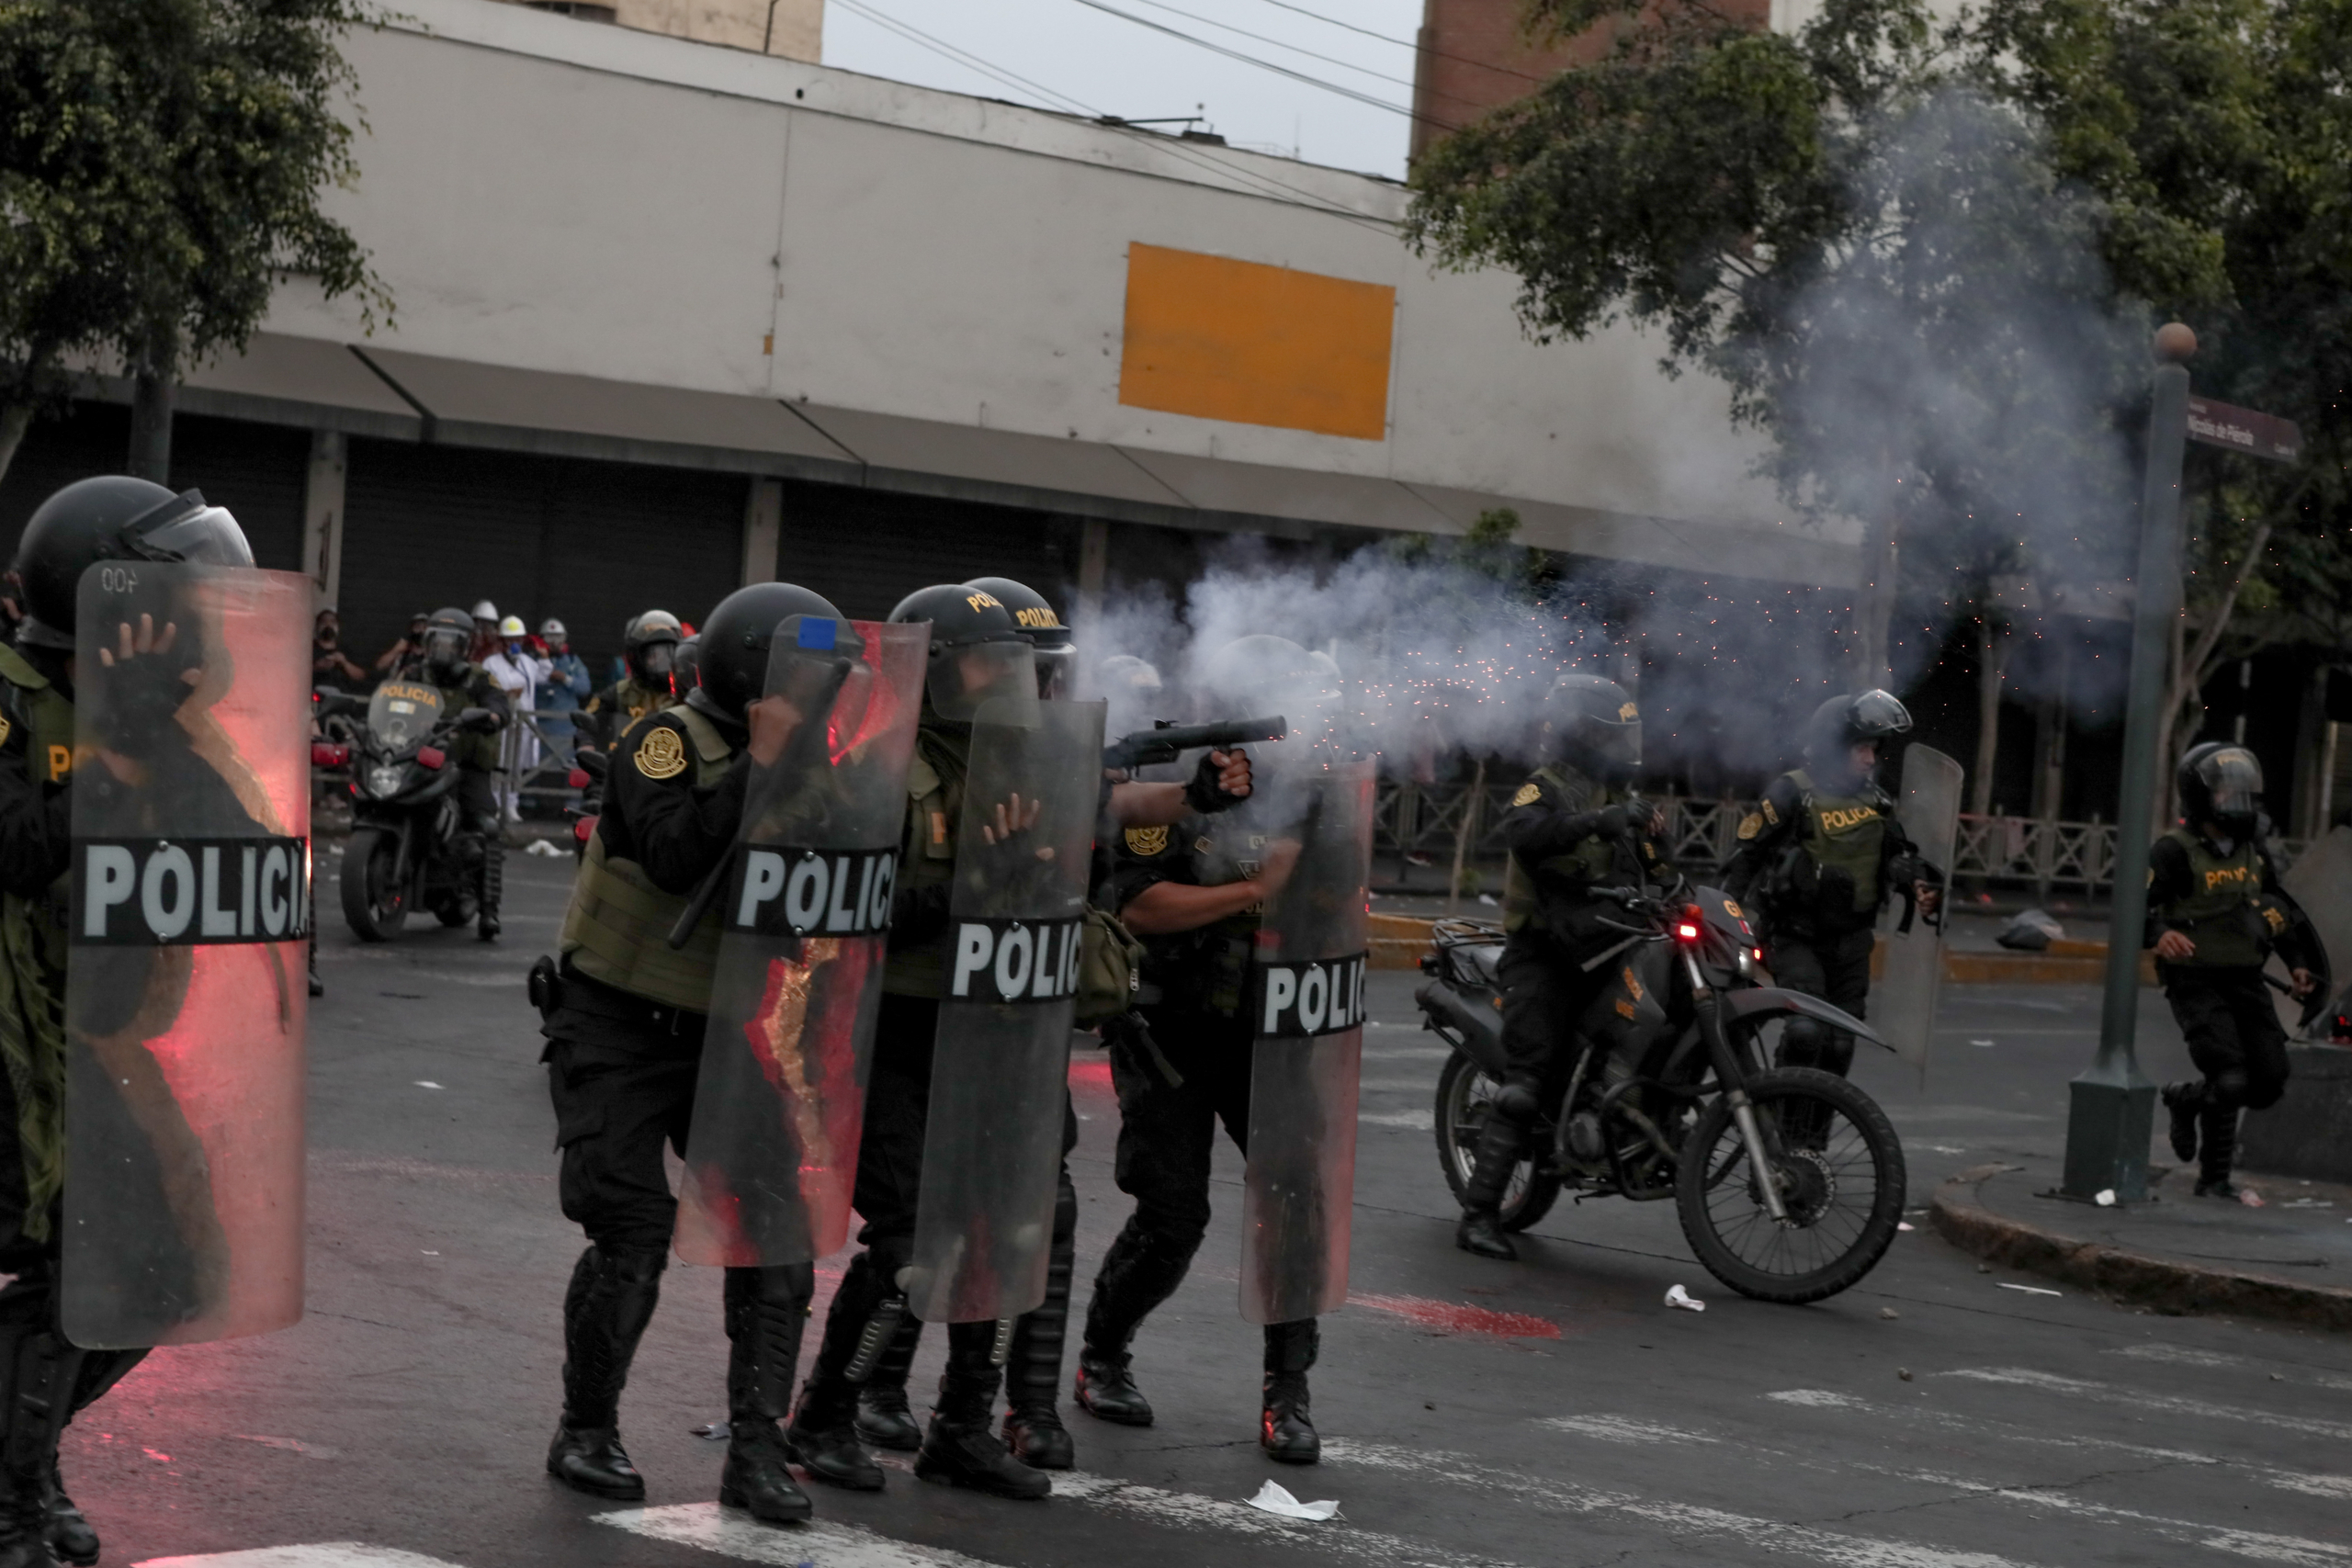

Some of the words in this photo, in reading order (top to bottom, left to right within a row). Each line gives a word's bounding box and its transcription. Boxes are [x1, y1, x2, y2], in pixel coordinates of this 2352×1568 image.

[967, 592, 1003, 614] POL
[379, 684, 436, 708] POLICIA
[952, 921, 1082, 999] POLIC
